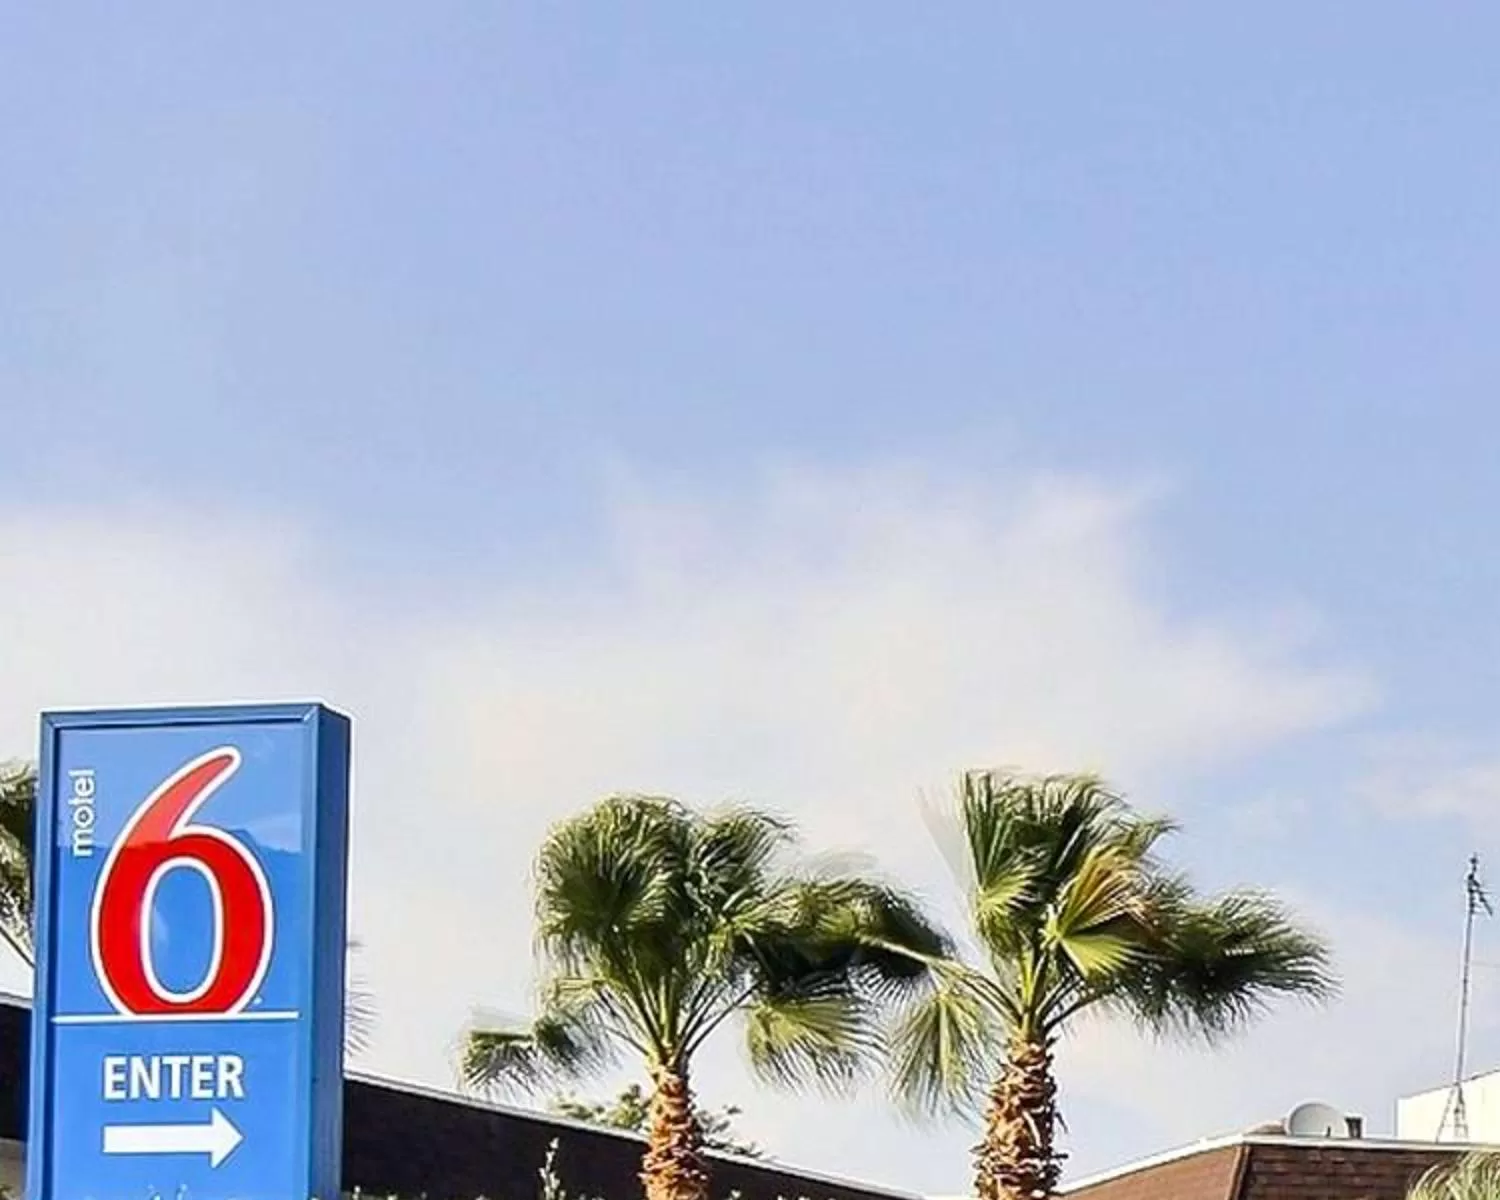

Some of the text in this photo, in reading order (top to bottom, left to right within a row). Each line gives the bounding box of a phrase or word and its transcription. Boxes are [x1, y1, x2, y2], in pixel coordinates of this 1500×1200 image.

[67, 769, 95, 857] motel
[91, 745, 274, 1015] 6
[103, 1055, 245, 1099] ENTER
